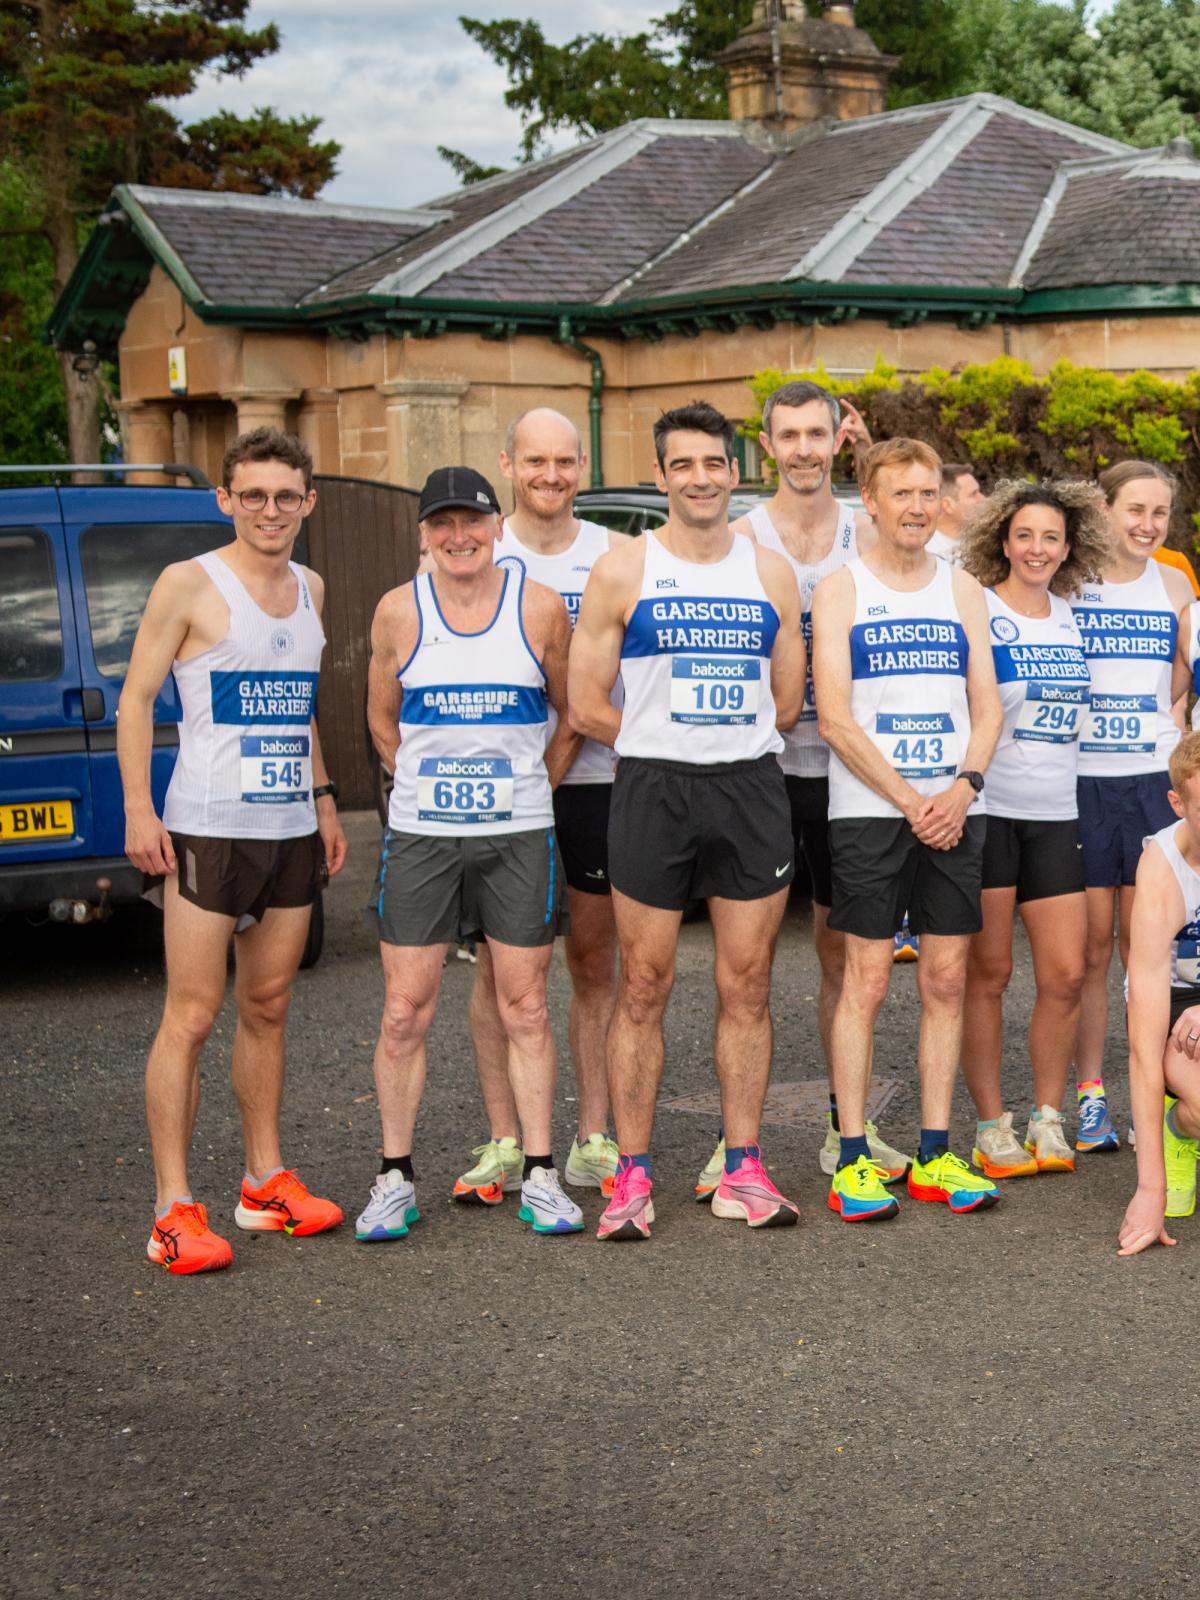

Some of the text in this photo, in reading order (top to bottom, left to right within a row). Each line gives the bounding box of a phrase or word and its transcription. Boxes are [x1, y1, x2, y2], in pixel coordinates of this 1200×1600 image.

[842, 524, 851, 549] soar
[656, 578, 679, 589] PSL
[1083, 593, 1103, 602] PSL
[652, 602, 764, 623] GARSCUBE
[867, 605, 890, 616] PSL
[1074, 613, 1172, 633] GARSCUBE
[656, 628, 762, 650] HARRIERS
[864, 624, 958, 646] GARSCUBE
[868, 650, 960, 672] HARRIERS
[1010, 647, 1085, 662] GARSCUBE
[691, 662, 745, 677] babcock
[1015, 663, 1090, 678] HARRIERS
[239, 681, 312, 698] GARSCUBE
[692, 683, 745, 710] 109
[1042, 686, 1082, 702] babcock
[423, 691, 518, 706] GARSCUBE
[1092, 697, 1141, 710] babcock
[240, 699, 309, 716] HARRIERS
[439, 704, 502, 715] HARRIERS
[892, 718, 943, 731] babcock
[1033, 704, 1078, 730] 294
[1092, 716, 1141, 740] 399
[260, 740, 303, 754] babcock
[893, 737, 944, 763] 443
[261, 761, 302, 788] 545
[437, 761, 492, 775] babcock
[433, 781, 496, 810] 683
